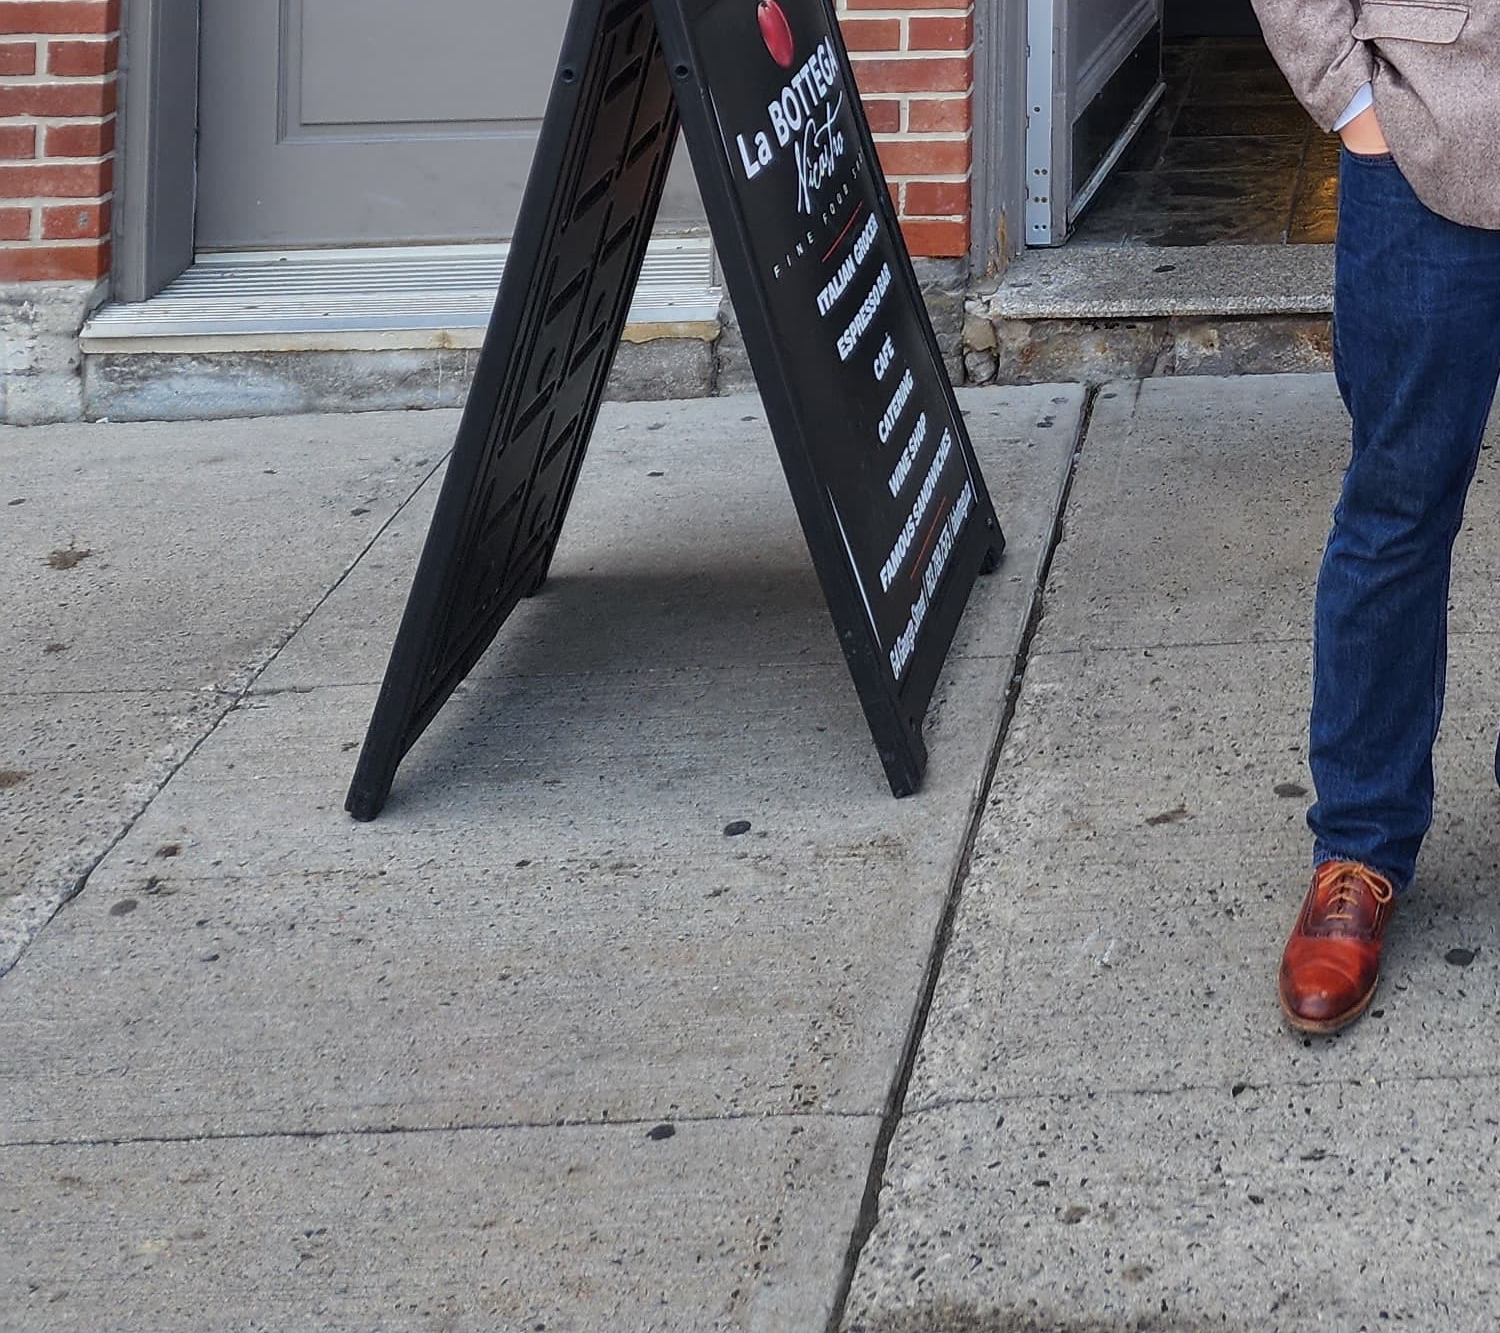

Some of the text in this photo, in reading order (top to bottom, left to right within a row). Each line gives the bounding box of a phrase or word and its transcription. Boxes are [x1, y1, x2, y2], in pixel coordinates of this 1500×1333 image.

[736, 35, 839, 180] La BOTTEGA
[773, 231, 815, 279] FINE
[822, 183, 850, 226] FOOD
[816, 253, 857, 317] ITALIAN
[836, 261, 892, 362] ESPRESSO BAR
[873, 331, 896, 381] CAFÉ
[878, 367, 915, 445] CATERING
[888, 411, 927, 499] WINE SHOP
[879, 426, 952, 594] FAMOUS SANDWICHES
